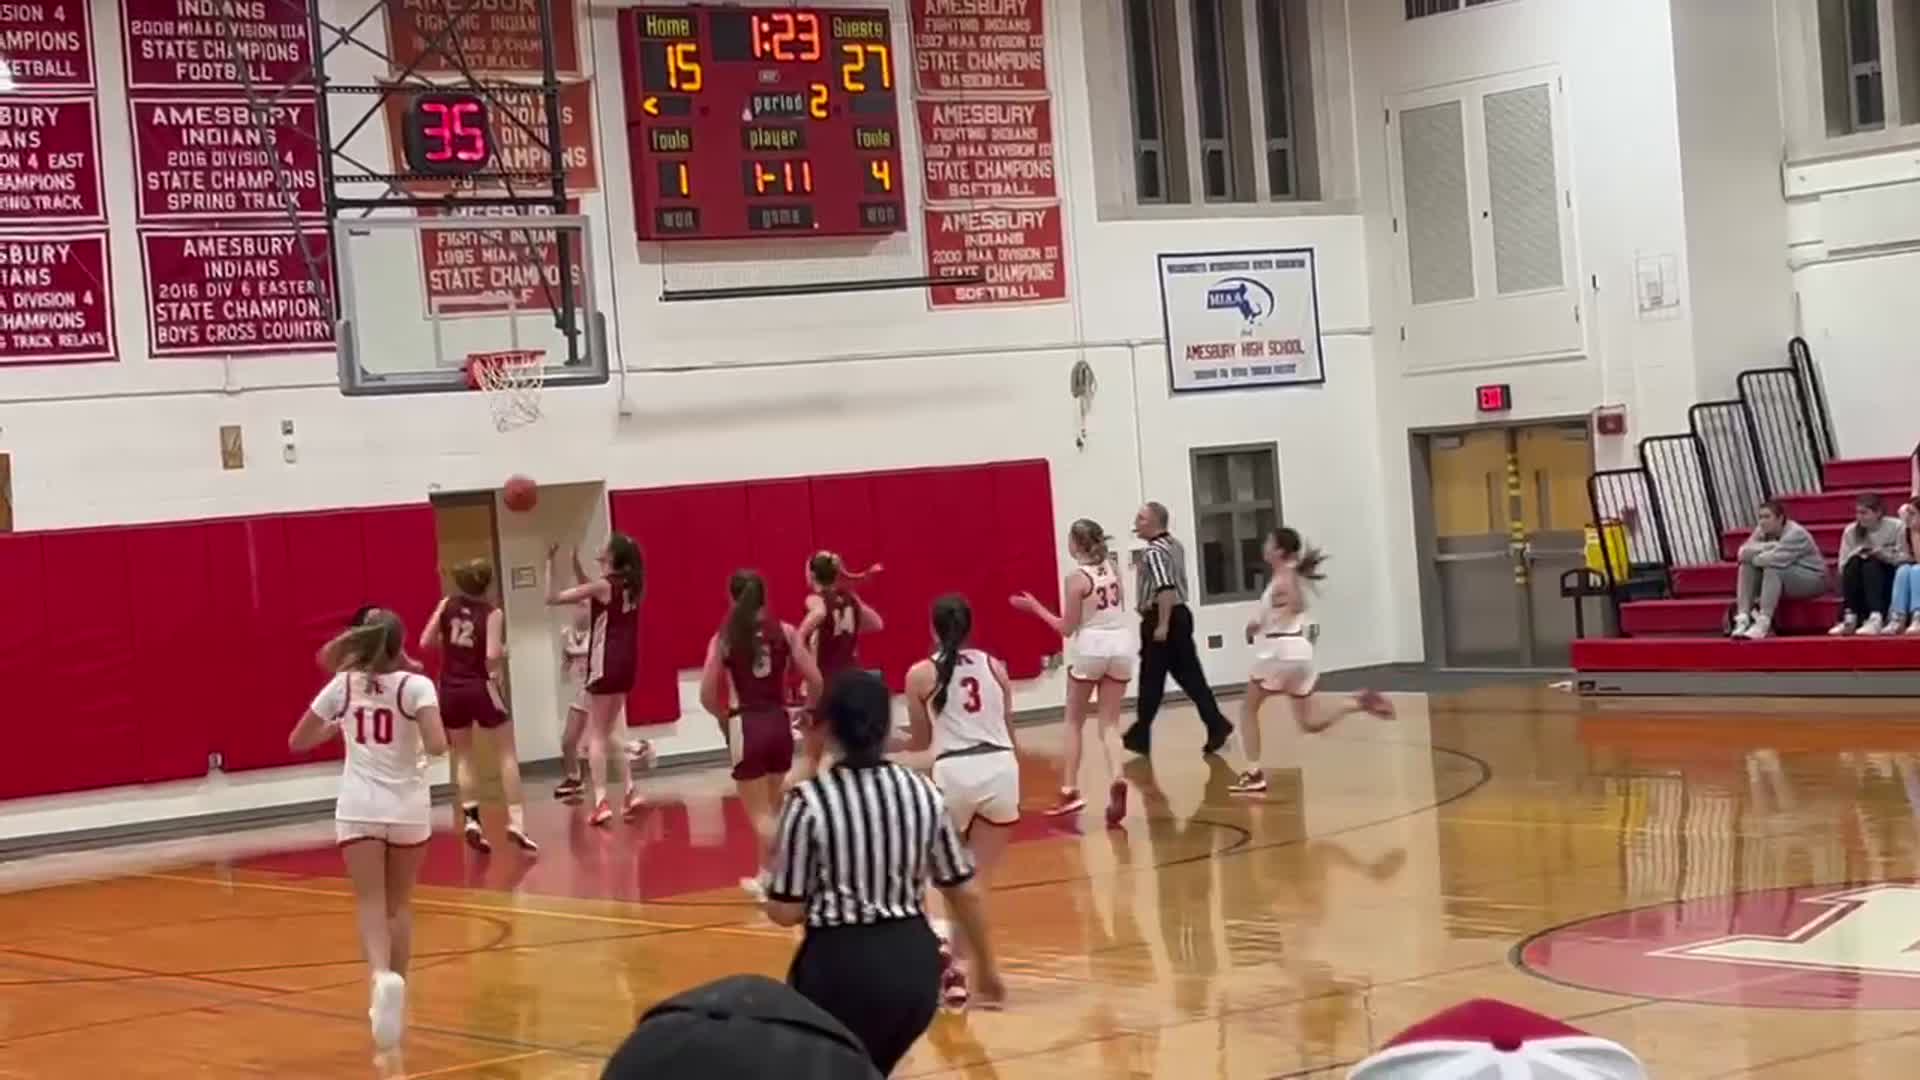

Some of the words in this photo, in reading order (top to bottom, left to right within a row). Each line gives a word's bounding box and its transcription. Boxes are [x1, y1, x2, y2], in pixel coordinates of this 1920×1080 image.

[54, 5, 66, 21] 4
[925, 0, 1028, 15] AMESBURY
[215, 22, 278, 38] DVISION
[646, 15, 690, 37] Home
[751, 13, 820, 60] 1:23
[832, 16, 884, 38] Guests
[142, 40, 199, 59] STATE
[176, 62, 273, 81] FOOTBLL
[667, 43, 702, 91] 15
[842, 44, 891, 91] 27
[918, 53, 961, 71] STATE
[967, 51, 1042, 71] CHAMPIONS
[940, 73, 1024, 87] BASEBALL
[753, 93, 803, 115] period
[811, 84, 828, 117] 2
[152, 107, 301, 125] AMESBURY
[932, 104, 1036, 124] AMESBURY
[182, 128, 277, 145] INDIANS
[421, 102, 485, 162] 35
[750, 127, 798, 150] player
[27, 153, 39, 169] 4
[48, 152, 84, 169] EAST
[212, 152, 280, 166] DIVISIO
[284, 152, 294, 165] 4
[147, 171, 206, 190] STATE
[211, 170, 316, 189] CHAMPONS
[679, 163, 689, 195] 1
[871, 160, 891, 191] 4
[927, 161, 971, 181] STATE
[975, 159, 1052, 179] CHAMPIONS
[949, 182, 1035, 197] SOFTBALL
[32, 194, 84, 209] TRACK
[167, 192, 236, 210] SPRING
[941, 210, 1046, 232] AMESBURY
[183, 236, 296, 258] AMESBURY
[964, 232, 1025, 247] INDIANS
[204, 260, 280, 278] INDIANS
[430, 267, 485, 291] STATE
[985, 262, 1055, 284] CHAMPIONS
[13, 292, 76, 308] DIVISION
[83, 290, 94, 306] 4
[159, 283, 199, 298] 2016
[206, 282, 233, 297] DIV
[241, 282, 251, 297] 6
[954, 285, 1040, 301] SOFTBALL
[155, 302, 215, 322] STATE
[223, 298, 330, 320] CHAMPION
[0, 312, 86, 330] HAMPIONS
[58, 332, 104, 347] RELAYS
[158, 325, 199, 344] BOYS
[205, 323, 257, 343] CROSS
[263, 321, 331, 341] COUNTRY
[1186, 343, 1237, 361] AMESBURY
[1241, 341, 1265, 357] HIGH
[1267, 338, 1305, 356] SCHOOL
[1096, 582, 1120, 610] 33
[450, 616, 475, 647] 12
[960, 676, 982, 713] 3
[354, 706, 394, 745] 10
